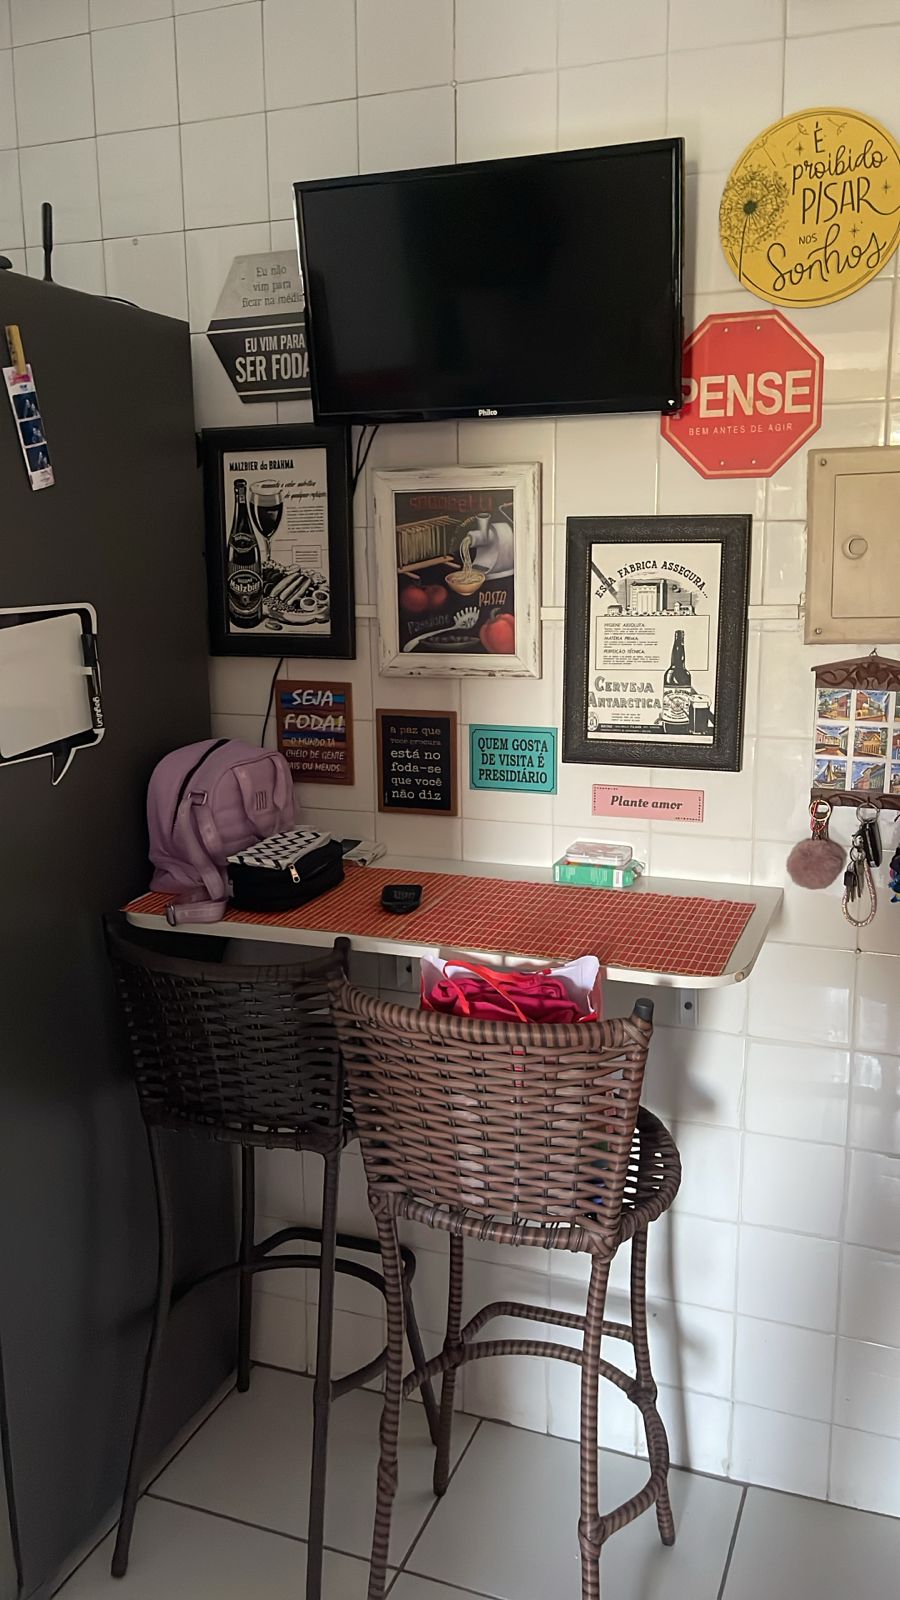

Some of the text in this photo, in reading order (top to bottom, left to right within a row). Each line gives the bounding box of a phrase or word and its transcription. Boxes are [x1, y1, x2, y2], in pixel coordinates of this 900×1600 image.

[814, 121, 825, 154] É
[792, 139, 888, 195] proibido
[802, 176, 900, 225] PISAR
[767, 223, 887, 292] Sonhos
[256, 267, 268, 277] Eu
[253, 281, 291, 293] vim para
[242, 297, 262, 308] ficar
[264, 297, 276, 306] na
[245, 333, 305, 353] EU VIM PARA
[235, 355, 267, 383] SER
[478, 408, 498, 417] Philco
[689, 422, 793, 436] BEM ANTES DE AGIR
[229, 461, 258, 472] MALZBIER
[269, 459, 294, 470] BRAHMA
[478, 590, 507, 607] PASTA
[594, 675, 654, 693] CERVEJA
[291, 689, 334, 706] SEJA
[588, 691, 662, 709] ANTARCTICA
[284, 713, 344, 731] FODA!
[399, 726, 418, 735] paz
[421, 727, 441, 736] que
[298, 737, 325, 747] MUNDO
[477, 737, 548, 753] QUEM GOSTA
[286, 749, 345, 760] CHEIO DE GENTE
[390, 748, 441, 760] está no
[481, 752, 545, 768] DE VISITA É
[302, 762, 313, 770] OU
[390, 762, 442, 774] foda-se
[391, 777, 442, 787] que você
[478, 767, 548, 784] PRESIDIÁRIO
[391, 789, 415, 799] não
[419, 789, 442, 801] diz
[610, 795, 683, 810] Plante amor
